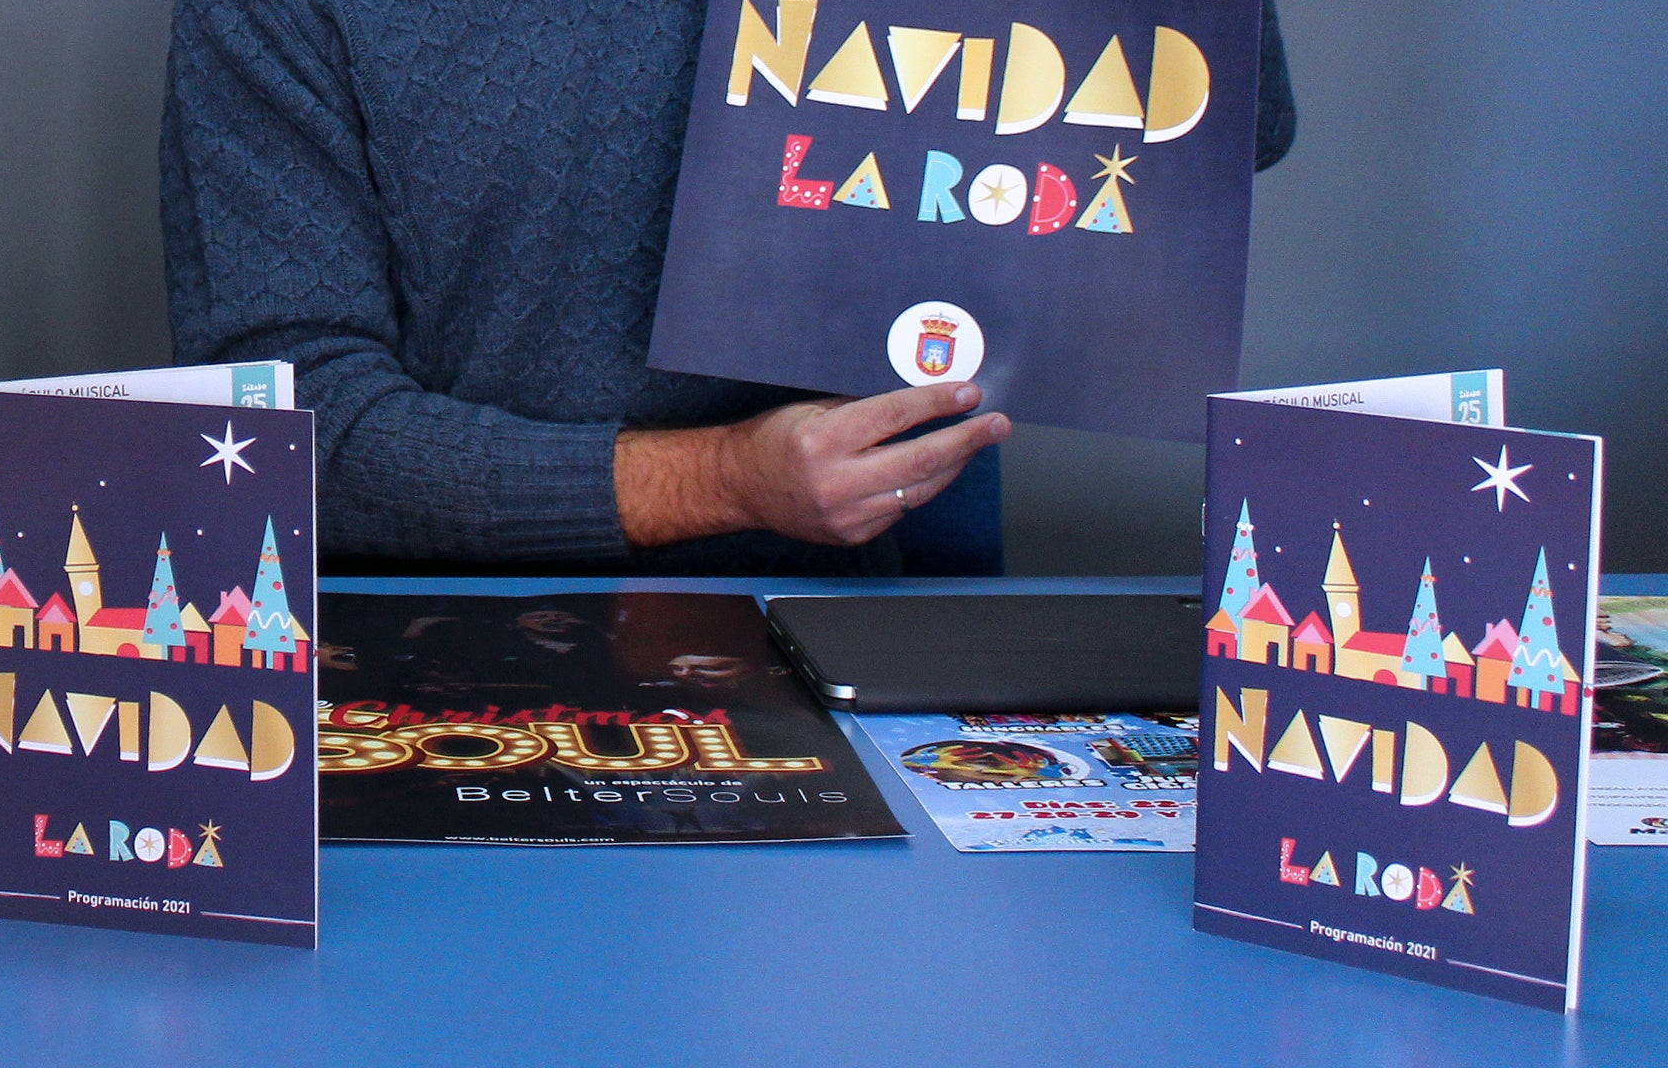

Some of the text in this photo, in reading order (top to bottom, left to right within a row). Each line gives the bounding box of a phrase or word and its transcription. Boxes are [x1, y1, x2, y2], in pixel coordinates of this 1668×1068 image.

[778, 134, 1139, 235] LA RODA
[68, 384, 130, 398] MUSICAL
[1312, 391, 1365, 407] MUSICAL
[1458, 399, 1482, 424] 25
[1214, 685, 1559, 828] NAVIDAD
[612, 779, 715, 787] espectáculo
[943, 779, 1105, 790] TALLERES
[456, 785, 848, 803] BelterSouls
[1023, 799, 1117, 809] DÍAS:
[969, 810, 1178, 820] 27-28-29 Y
[35, 814, 223, 869] LA RODA
[444, 835, 615, 843] www.beltersouls.com
[1280, 838, 1476, 916] LA RODA
[68, 890, 191, 914] Programación 2021
[1310, 920, 1437, 961] Programación 2021
